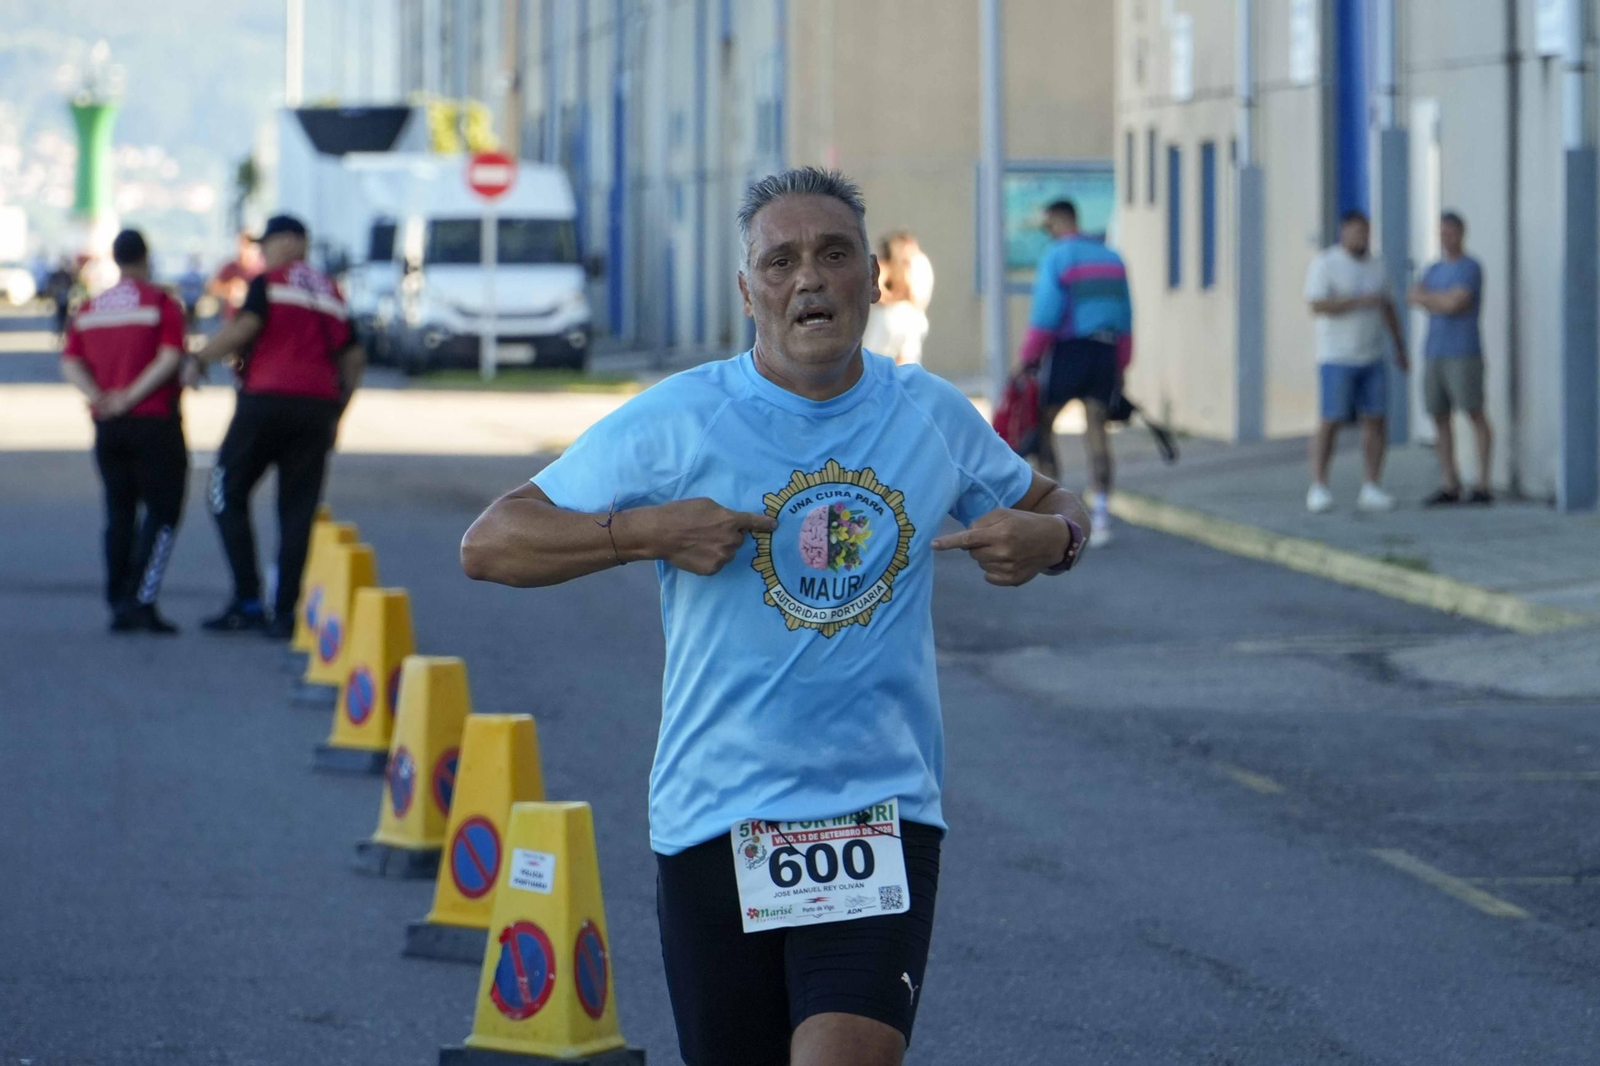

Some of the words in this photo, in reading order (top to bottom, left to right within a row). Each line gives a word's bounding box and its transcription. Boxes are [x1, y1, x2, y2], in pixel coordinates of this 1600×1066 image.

[788, 497, 813, 514] UNA
[816, 491, 852, 501] CURA
[855, 493, 885, 516] PARA
[799, 575, 866, 601] MAURI
[773, 589, 827, 620] AUTORIDAD
[831, 584, 885, 619] PORTUARIA
[797, 833, 807, 842] 13
[808, 832, 819, 841] DE
[820, 828, 861, 840] SETEMBRO
[862, 826, 873, 836] DE
[769, 839, 875, 888] 600
[773, 889, 792, 899] JOSE
[793, 885, 822, 896] MANUEL
[823, 883, 837, 892] REY
[755, 905, 793, 918] Marisé
